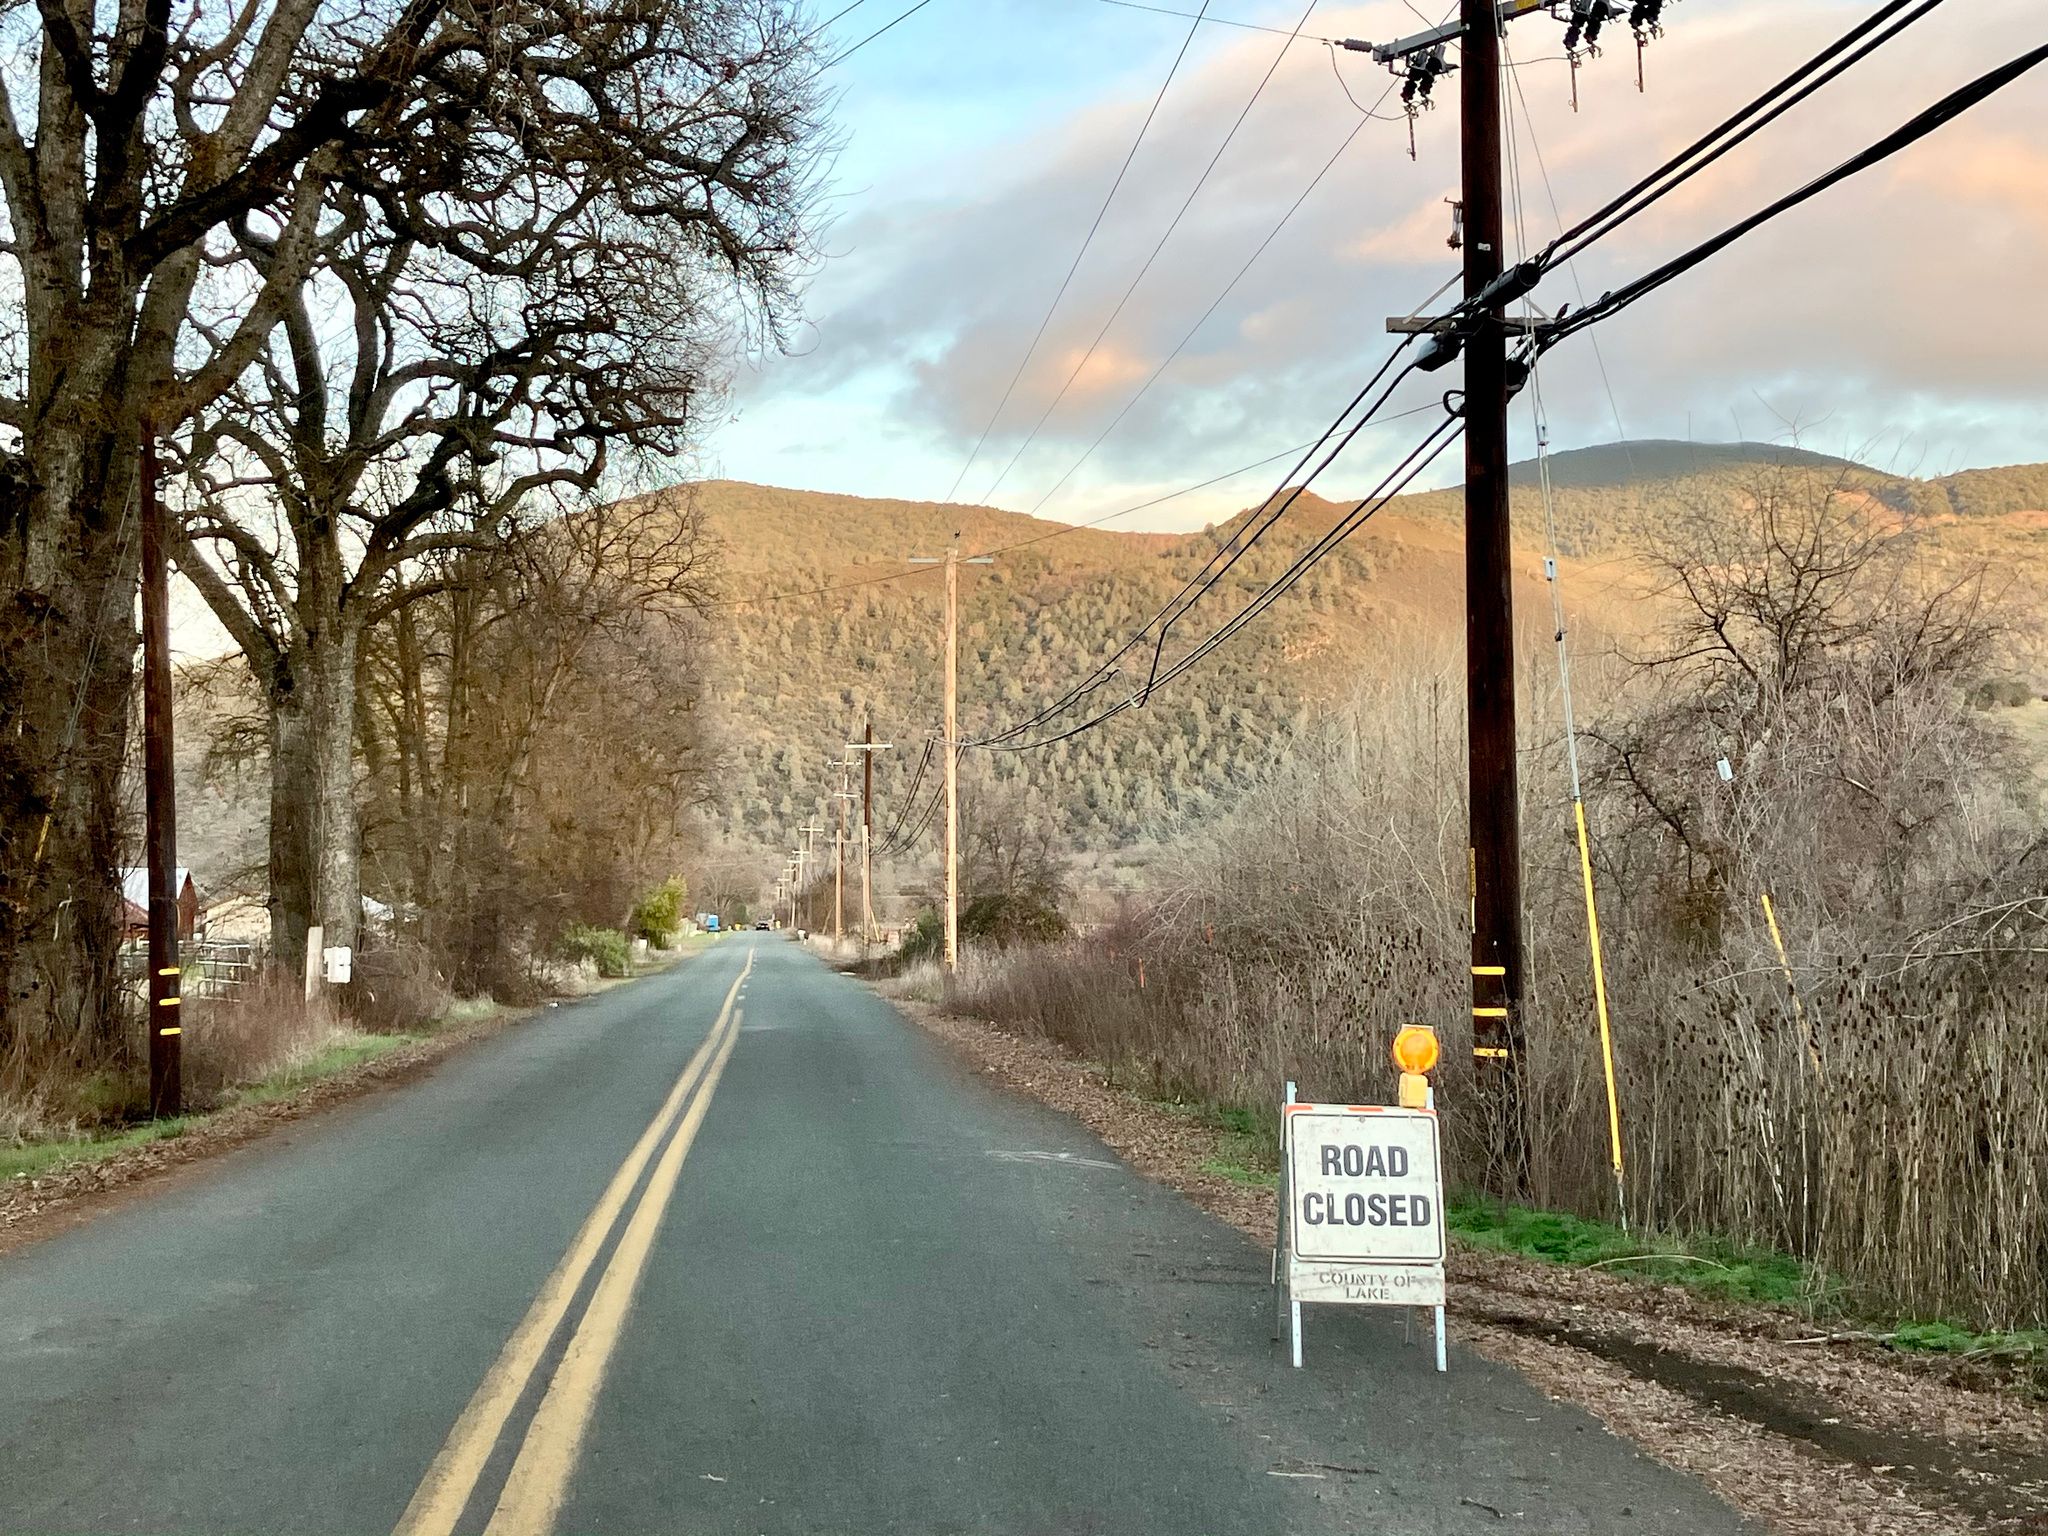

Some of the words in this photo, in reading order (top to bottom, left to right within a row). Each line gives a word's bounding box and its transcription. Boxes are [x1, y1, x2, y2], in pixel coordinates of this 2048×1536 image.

[1320, 1144, 1409, 1177] ROAD
[1302, 1191, 1431, 1226] CLOSED
[1319, 1271, 1388, 1287] COUNTY
[1393, 1274, 1417, 1288] OF
[1345, 1287, 1390, 1300] LAKE
